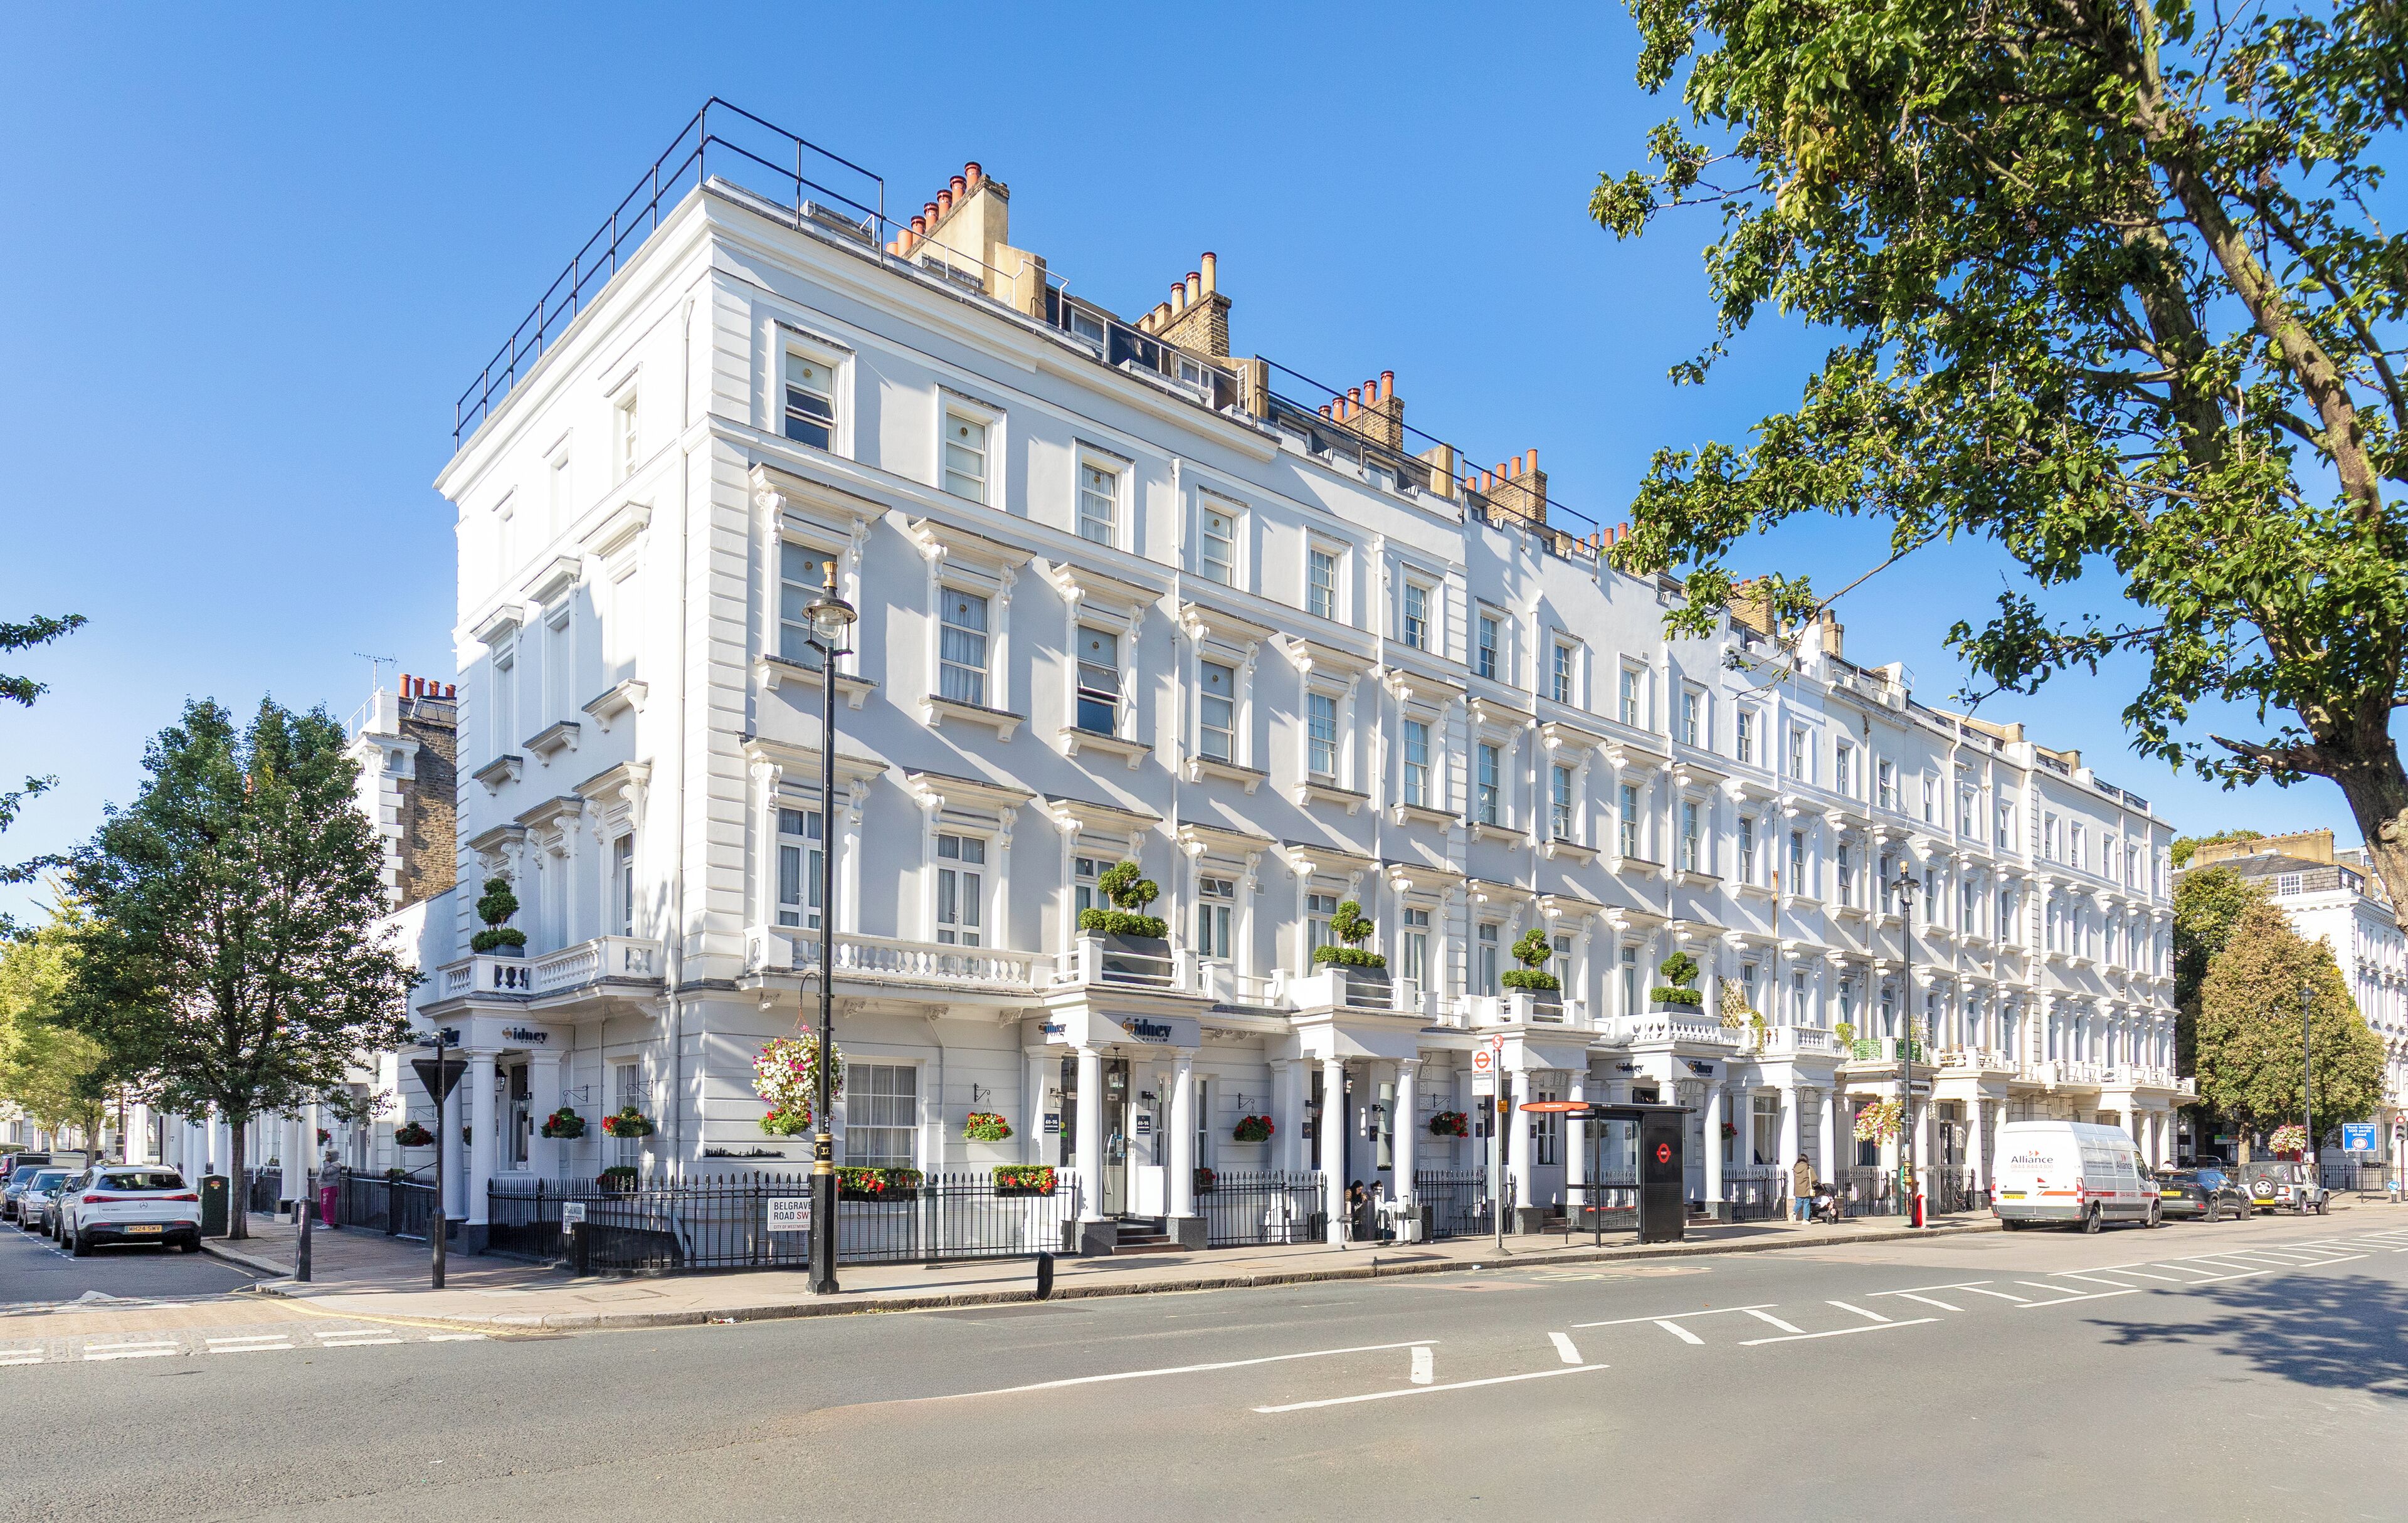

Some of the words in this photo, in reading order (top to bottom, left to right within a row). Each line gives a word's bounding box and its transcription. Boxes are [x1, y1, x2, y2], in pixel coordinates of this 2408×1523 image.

[1494, 1036, 1501, 1048] S
[825, 1117, 829, 1128] 34
[774, 1201, 811, 1210] BELGRAVE
[774, 1211, 795, 1220] ROAD
[796, 1211, 811, 1220] SW
